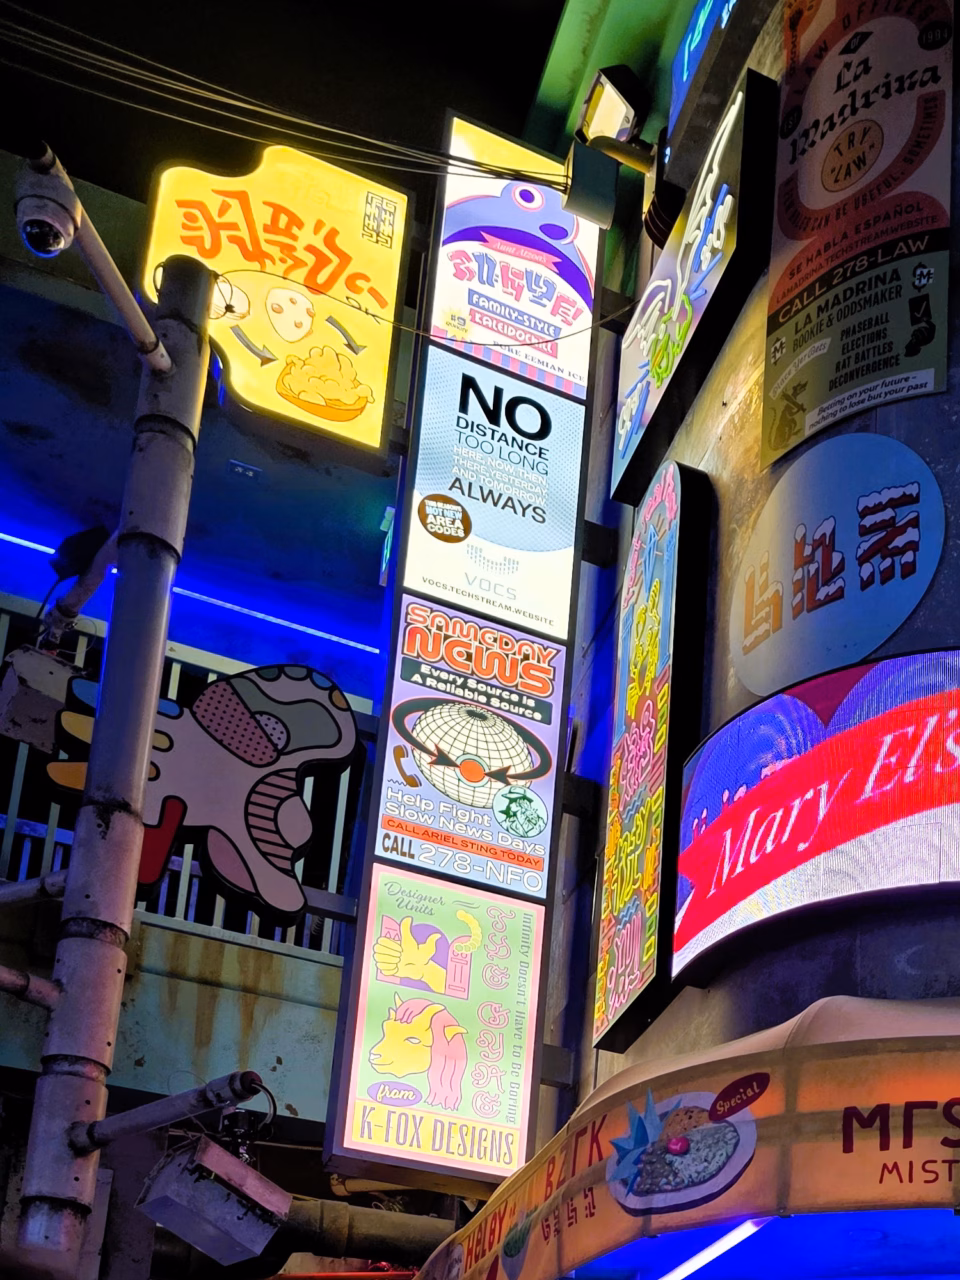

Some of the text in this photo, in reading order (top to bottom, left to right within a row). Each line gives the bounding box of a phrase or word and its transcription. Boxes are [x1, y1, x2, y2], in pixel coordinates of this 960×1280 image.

[834, 56, 873, 95] La
[789, 65, 942, 164] Madrina
[834, 126, 871, 157] TRY
[788, 201, 924, 280] SE HABLA ESPAÑOL
[778, 235, 930, 323] CALL 278-LAW
[471, 293, 556, 338] FAMILY-STYLE
[792, 285, 903, 353] BOOKIE & ODDSMAKER
[794, 267, 902, 336] LA MADRINA
[840, 312, 890, 341] PHASEBALL
[841, 327, 888, 356] ELECTIONS
[828, 353, 901, 393] DECONVERGENCE
[835, 341, 894, 374] RAT BATTLES
[458, 372, 552, 441] NO
[849, 397, 866, 410] lose
[866, 391, 883, 402] but
[884, 385, 906, 401] your
[906, 381, 928, 395] past
[858, 384, 880, 401] your
[880, 375, 909, 391] future
[454, 429, 549, 476] TOO LONG
[455, 415, 550, 462] DISTANCE
[452, 466, 477, 481] AND
[426, 515, 464, 529] AREA
[448, 477, 547, 524] ALWAYS
[426, 524, 465, 537] CODES
[464, 572, 517, 601] VOCS
[407, 602, 558, 666] SAMEDAY
[402, 624, 554, 698] NEWS
[410, 673, 542, 721] A Reliable Source
[420, 664, 465, 686] Every
[466, 679, 520, 702] Source
[385, 802, 545, 856] Slow News Days
[386, 787, 491, 828] Help Fight
[387, 818, 540, 867] CALL ARIEL STING TODAY
[706, 766, 854, 901] Mary
[382, 832, 543, 892] CALL 278-NFO
[384, 881, 446, 906] Designer
[395, 896, 435, 917] Units
[520, 912, 533, 958] Infinity
[513, 1011, 526, 1041] Have
[376, 1083, 416, 1101] from
[715, 1081, 762, 1116] Special
[360, 1105, 514, 1166] K-FOX DESIGNS
